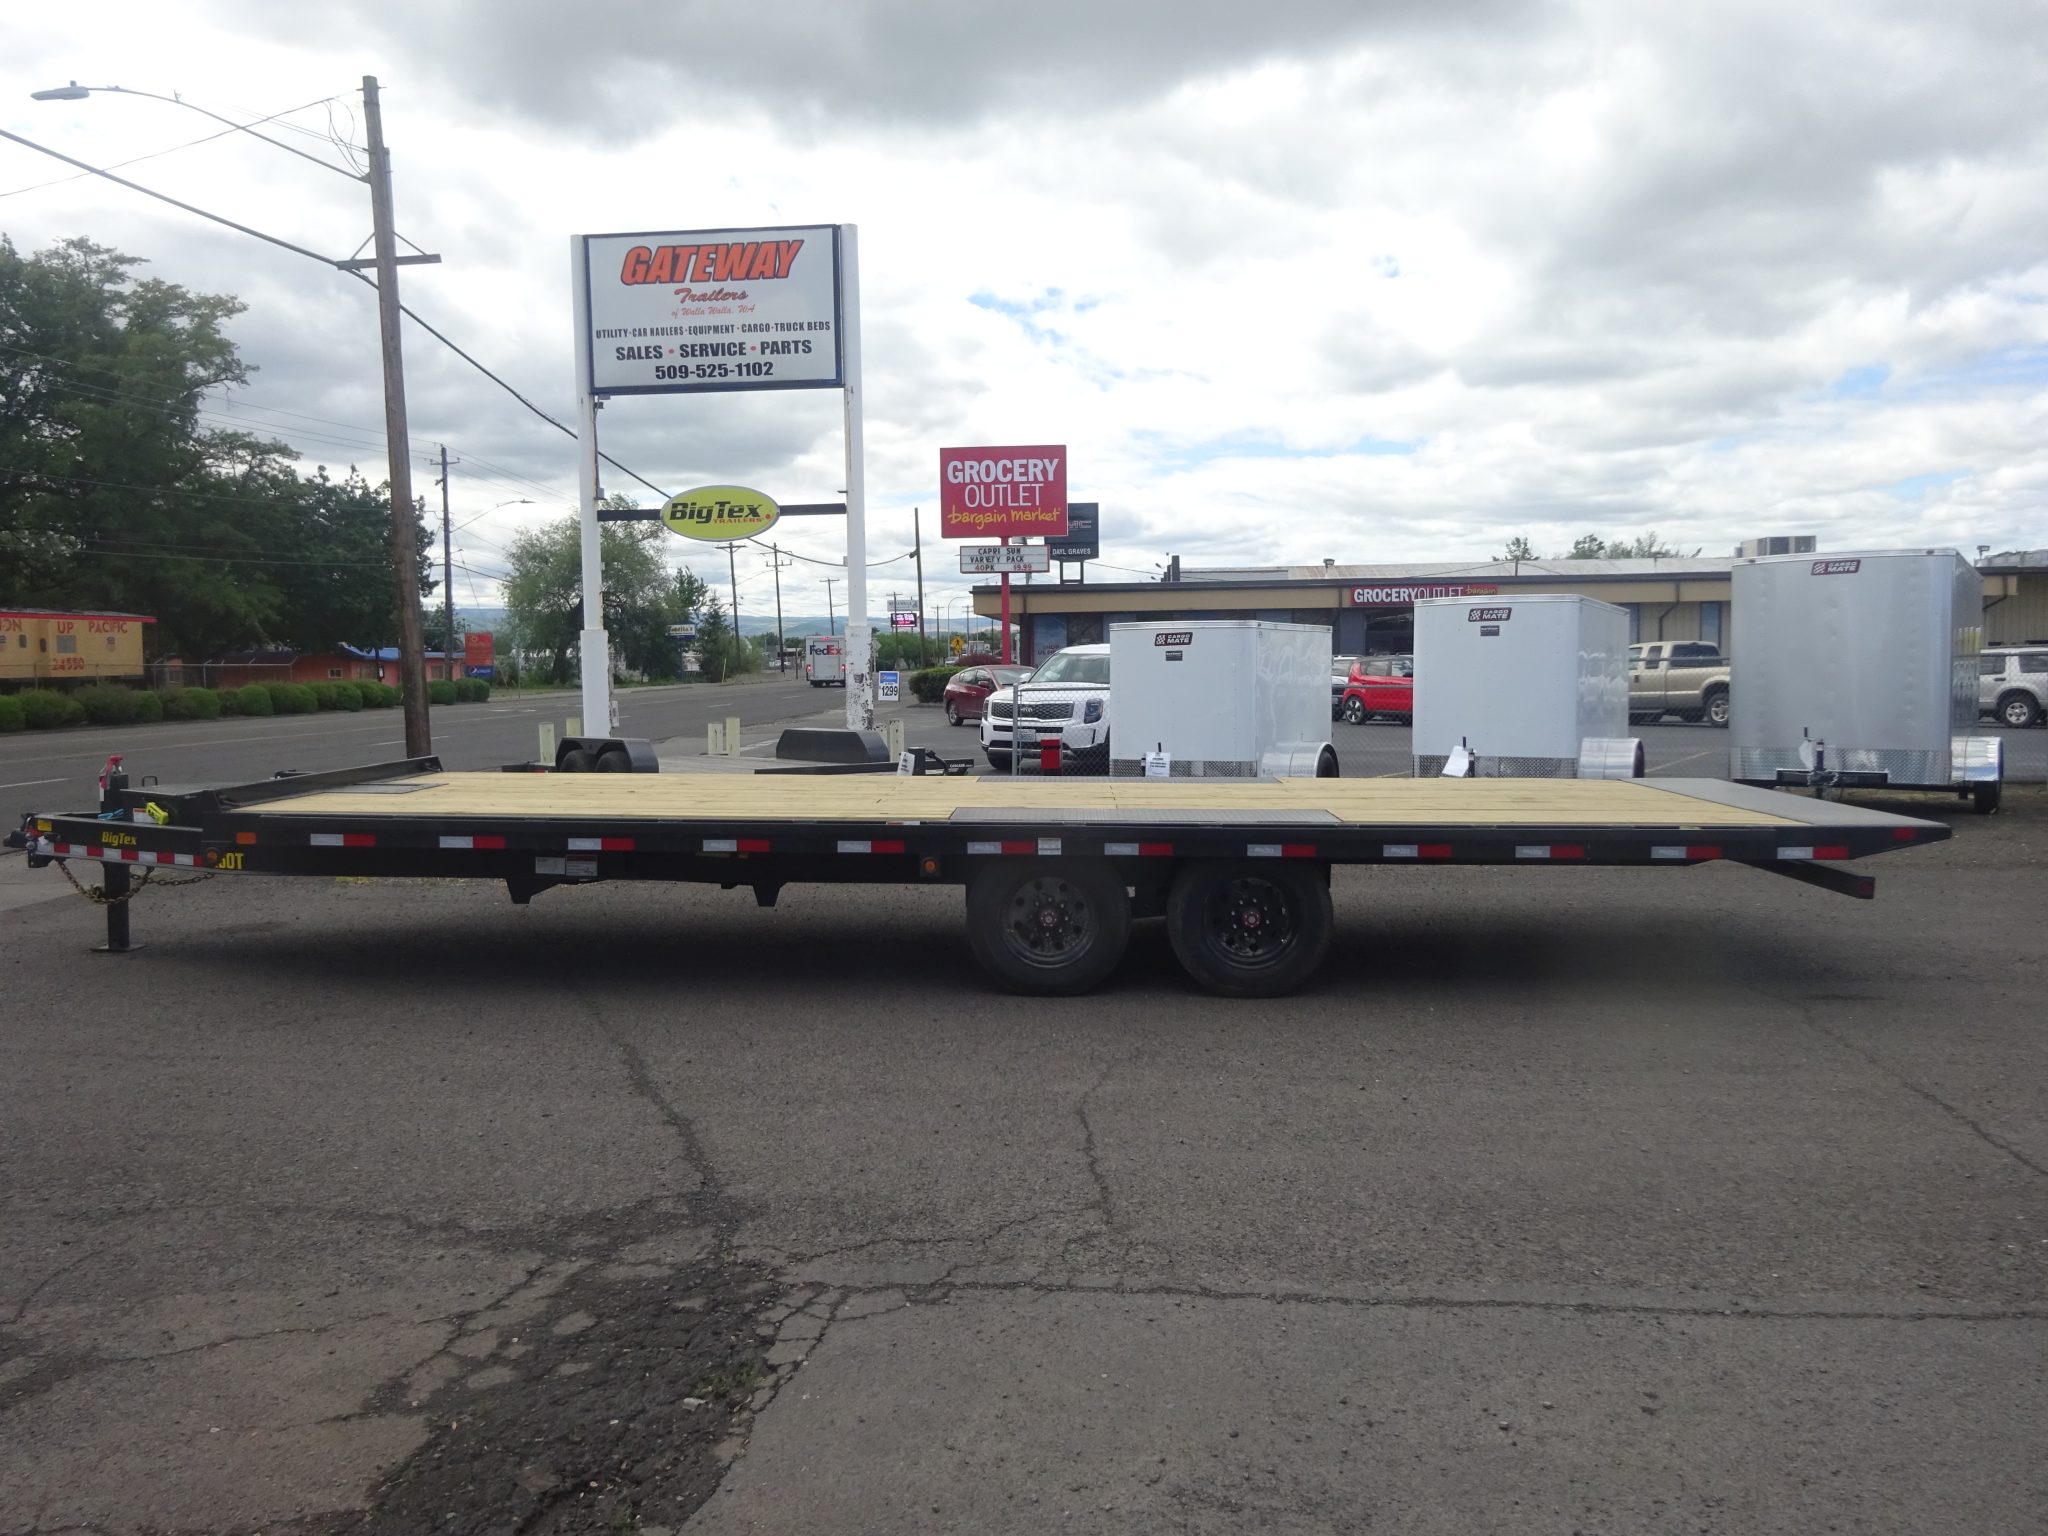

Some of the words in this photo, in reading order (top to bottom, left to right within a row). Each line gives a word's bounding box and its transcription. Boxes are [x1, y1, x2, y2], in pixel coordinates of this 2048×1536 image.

[620, 239, 804, 286] GATEWAY
[674, 287, 748, 304] Trailers
[671, 309, 680, 319] of
[681, 305, 706, 316] Walla
[738, 303, 756, 314] WA
[596, 327, 629, 339] UTILITY
[632, 326, 648, 337] CAR
[650, 325, 684, 337] HAULERS
[688, 324, 735, 336] EQUIPMENT
[741, 322, 771, 333] CARGO
[774, 321, 805, 332] TRUCK
[807, 320, 831, 331] BEDS
[615, 345, 663, 361] SALES
[679, 341, 747, 358] SERVICE
[760, 339, 812, 355] PARTS
[655, 361, 774, 380] 509-525-1102
[947, 458, 1060, 484] GROCERY
[964, 483, 1044, 508] OUTLET
[947, 505, 1007, 530] bargain
[1011, 507, 1060, 524] market
[978, 547, 1000, 555] CAPRI
[1006, 547, 1021, 555] SUN
[1006, 555, 1025, 563] PACK
[1068, 547, 1091, 555] GRAVES
[57, 621, 74, 634] UP
[88, 621, 128, 634] PACIFIC
[809, 644, 842, 656] FedEx
[101, 831, 137, 846] BigTex
